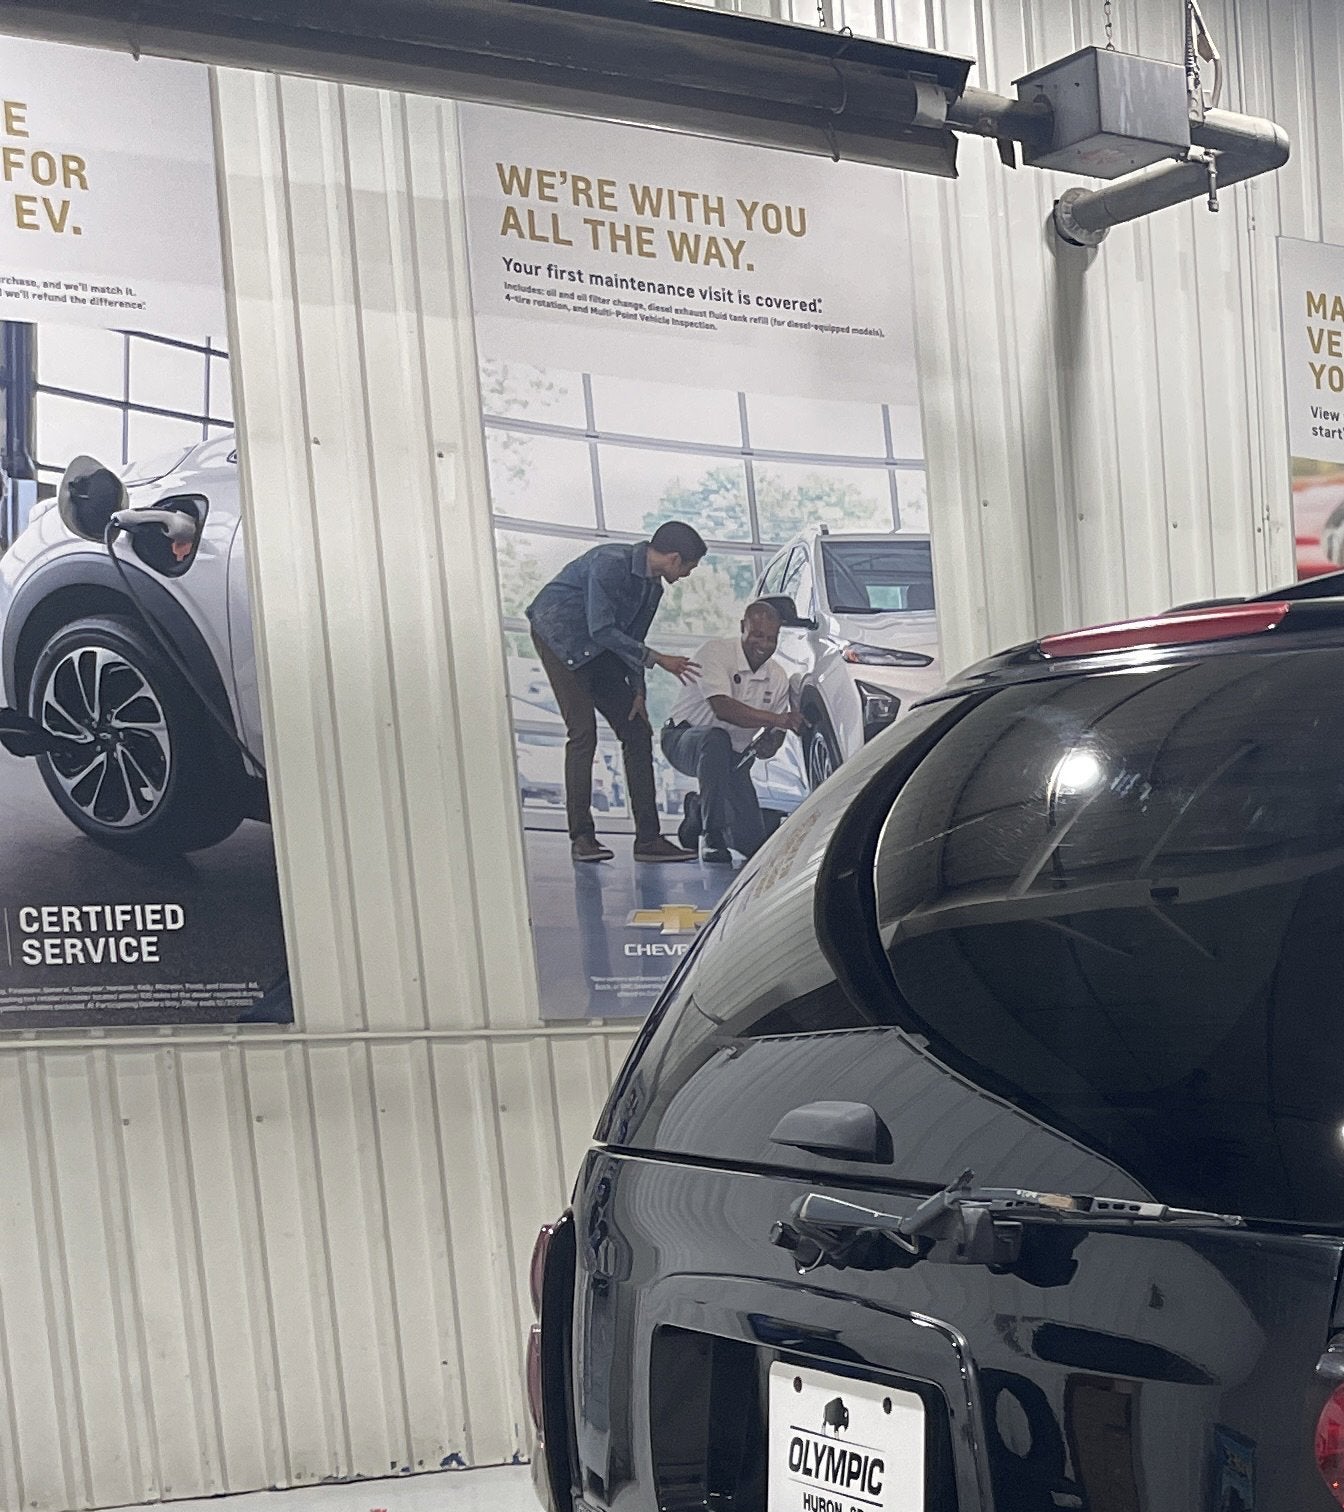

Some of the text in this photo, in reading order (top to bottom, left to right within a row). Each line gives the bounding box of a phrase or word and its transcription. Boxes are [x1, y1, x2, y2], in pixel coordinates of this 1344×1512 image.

[2, 146, 89, 191] FOR
[15, 194, 82, 235] EV.
[628, 183, 725, 229] WITH
[736, 198, 808, 238] YOU
[500, 205, 755, 272] ALL THE WAY.
[0, 276, 40, 289] rchase,
[43, 281, 61, 290] and
[64, 282, 87, 292] we'll
[91, 285, 122, 295] match
[5, 289, 29, 299] we'll
[32, 292, 67, 303] refund
[70, 295, 87, 304] the
[502, 257, 541, 278] Your
[546, 263, 584, 285] first
[589, 273, 696, 299] maintenance
[699, 286, 734, 304] visit
[737, 289, 751, 306] is
[504, 282, 545, 296] Includes:
[546, 288, 557, 297] oil
[559, 291, 575, 300] and
[577, 293, 587, 302] oil
[588, 294, 611, 305] filter
[612, 298, 646, 311] change,
[648, 302, 673, 314] diesel
[674, 307, 707, 318] exhaust
[708, 310, 728, 321] fluid
[729, 313, 748, 323] tank
[750, 316, 769, 326] refill
[770, 317, 786, 328] (for
[504, 293, 718, 331] 4-tire rotation, and Multi-Point Vehicle Inspection.
[1310, 405, 1340, 422] View
[19, 903, 185, 933] CERTIFIED
[22, 936, 160, 966] SERVICE
[624, 943, 690, 956] CHEVR
[788, 1436, 885, 1496] OLYMPIC
